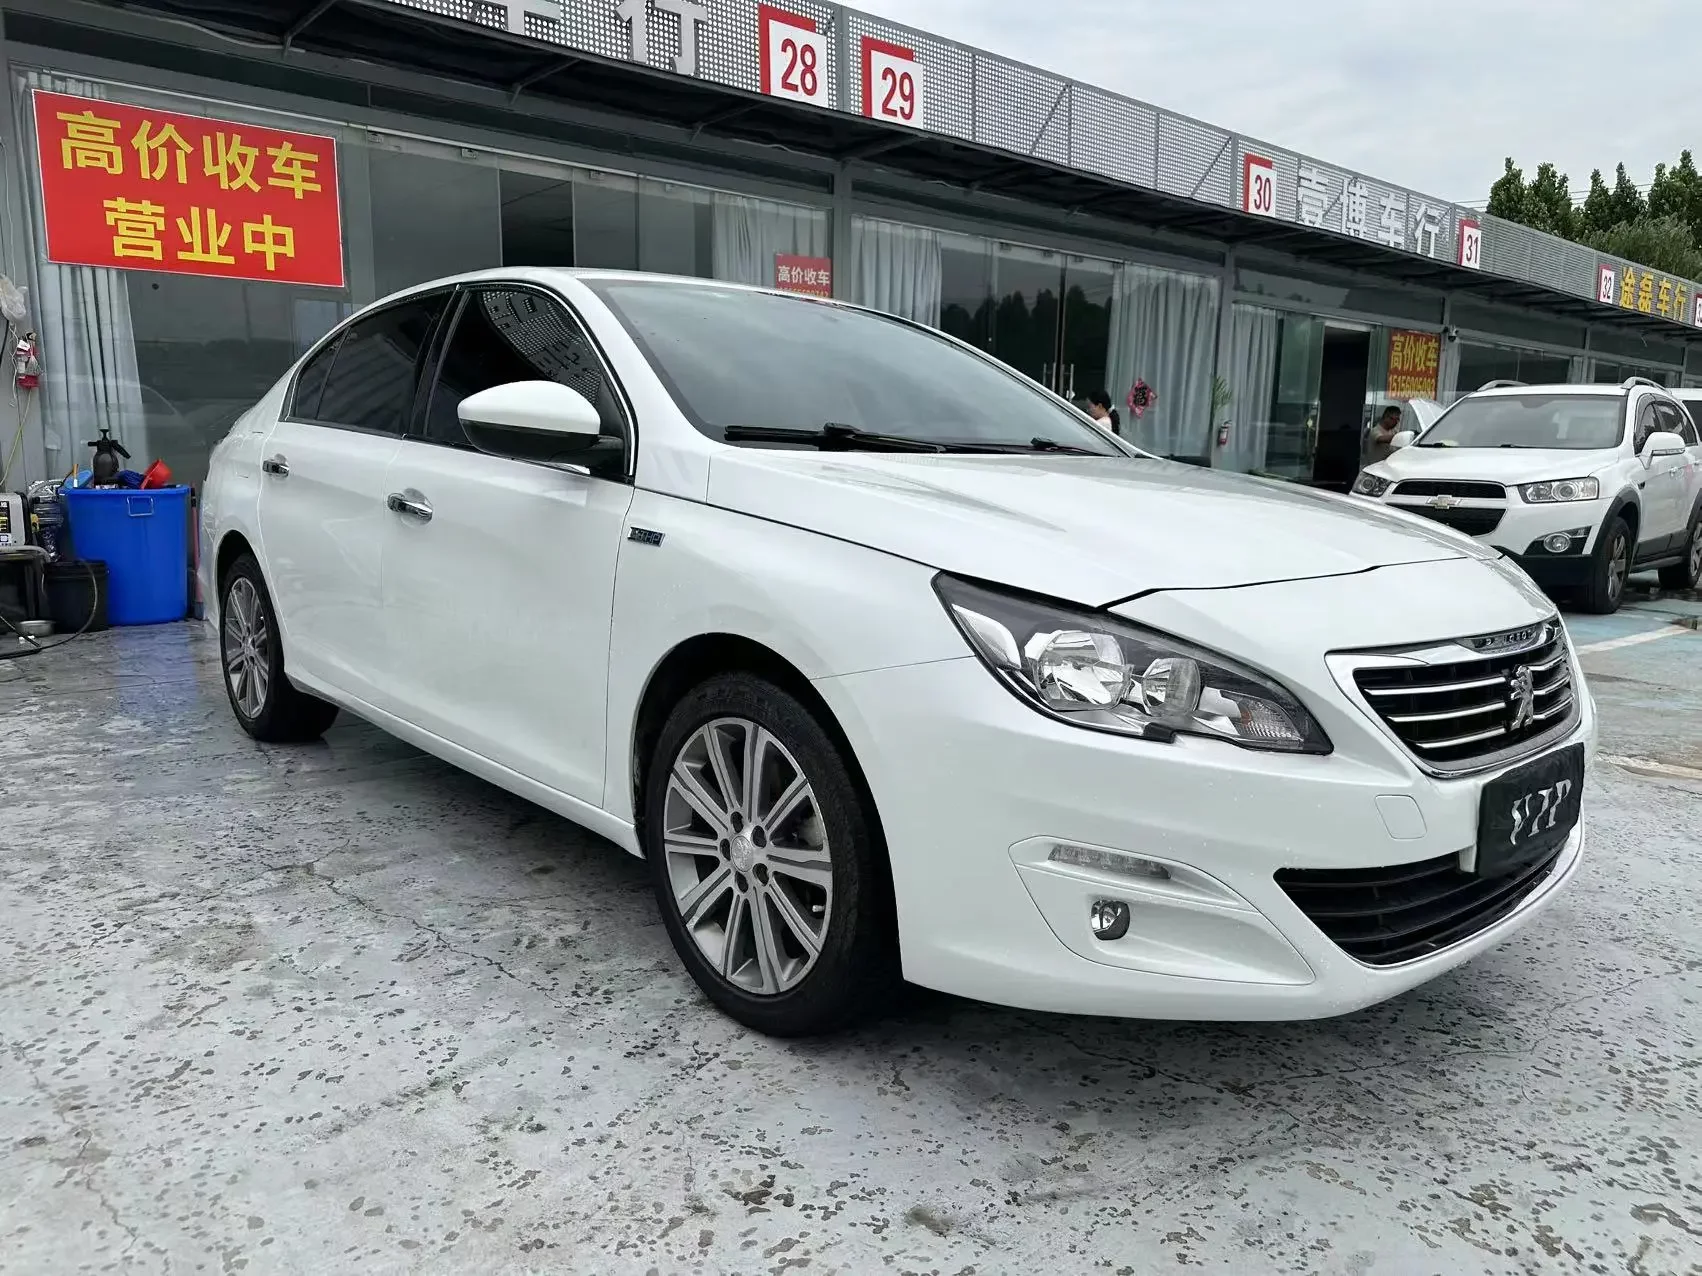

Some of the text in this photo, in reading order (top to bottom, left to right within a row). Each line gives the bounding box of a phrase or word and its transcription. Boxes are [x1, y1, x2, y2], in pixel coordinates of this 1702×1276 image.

[781, 38, 817, 96] 28
[882, 67, 914, 120] 29
[57, 111, 322, 200] 高价收车
[1254, 174, 1272, 212] 30
[103, 197, 295, 271] 营业中
[1466, 234, 1479, 263] 31
[778, 265, 830, 286] 高价收车
[1602, 275, 1612, 300] 32
[1391, 333, 1439, 374] 高价收车
[1510, 779, 1572, 845] VIP
